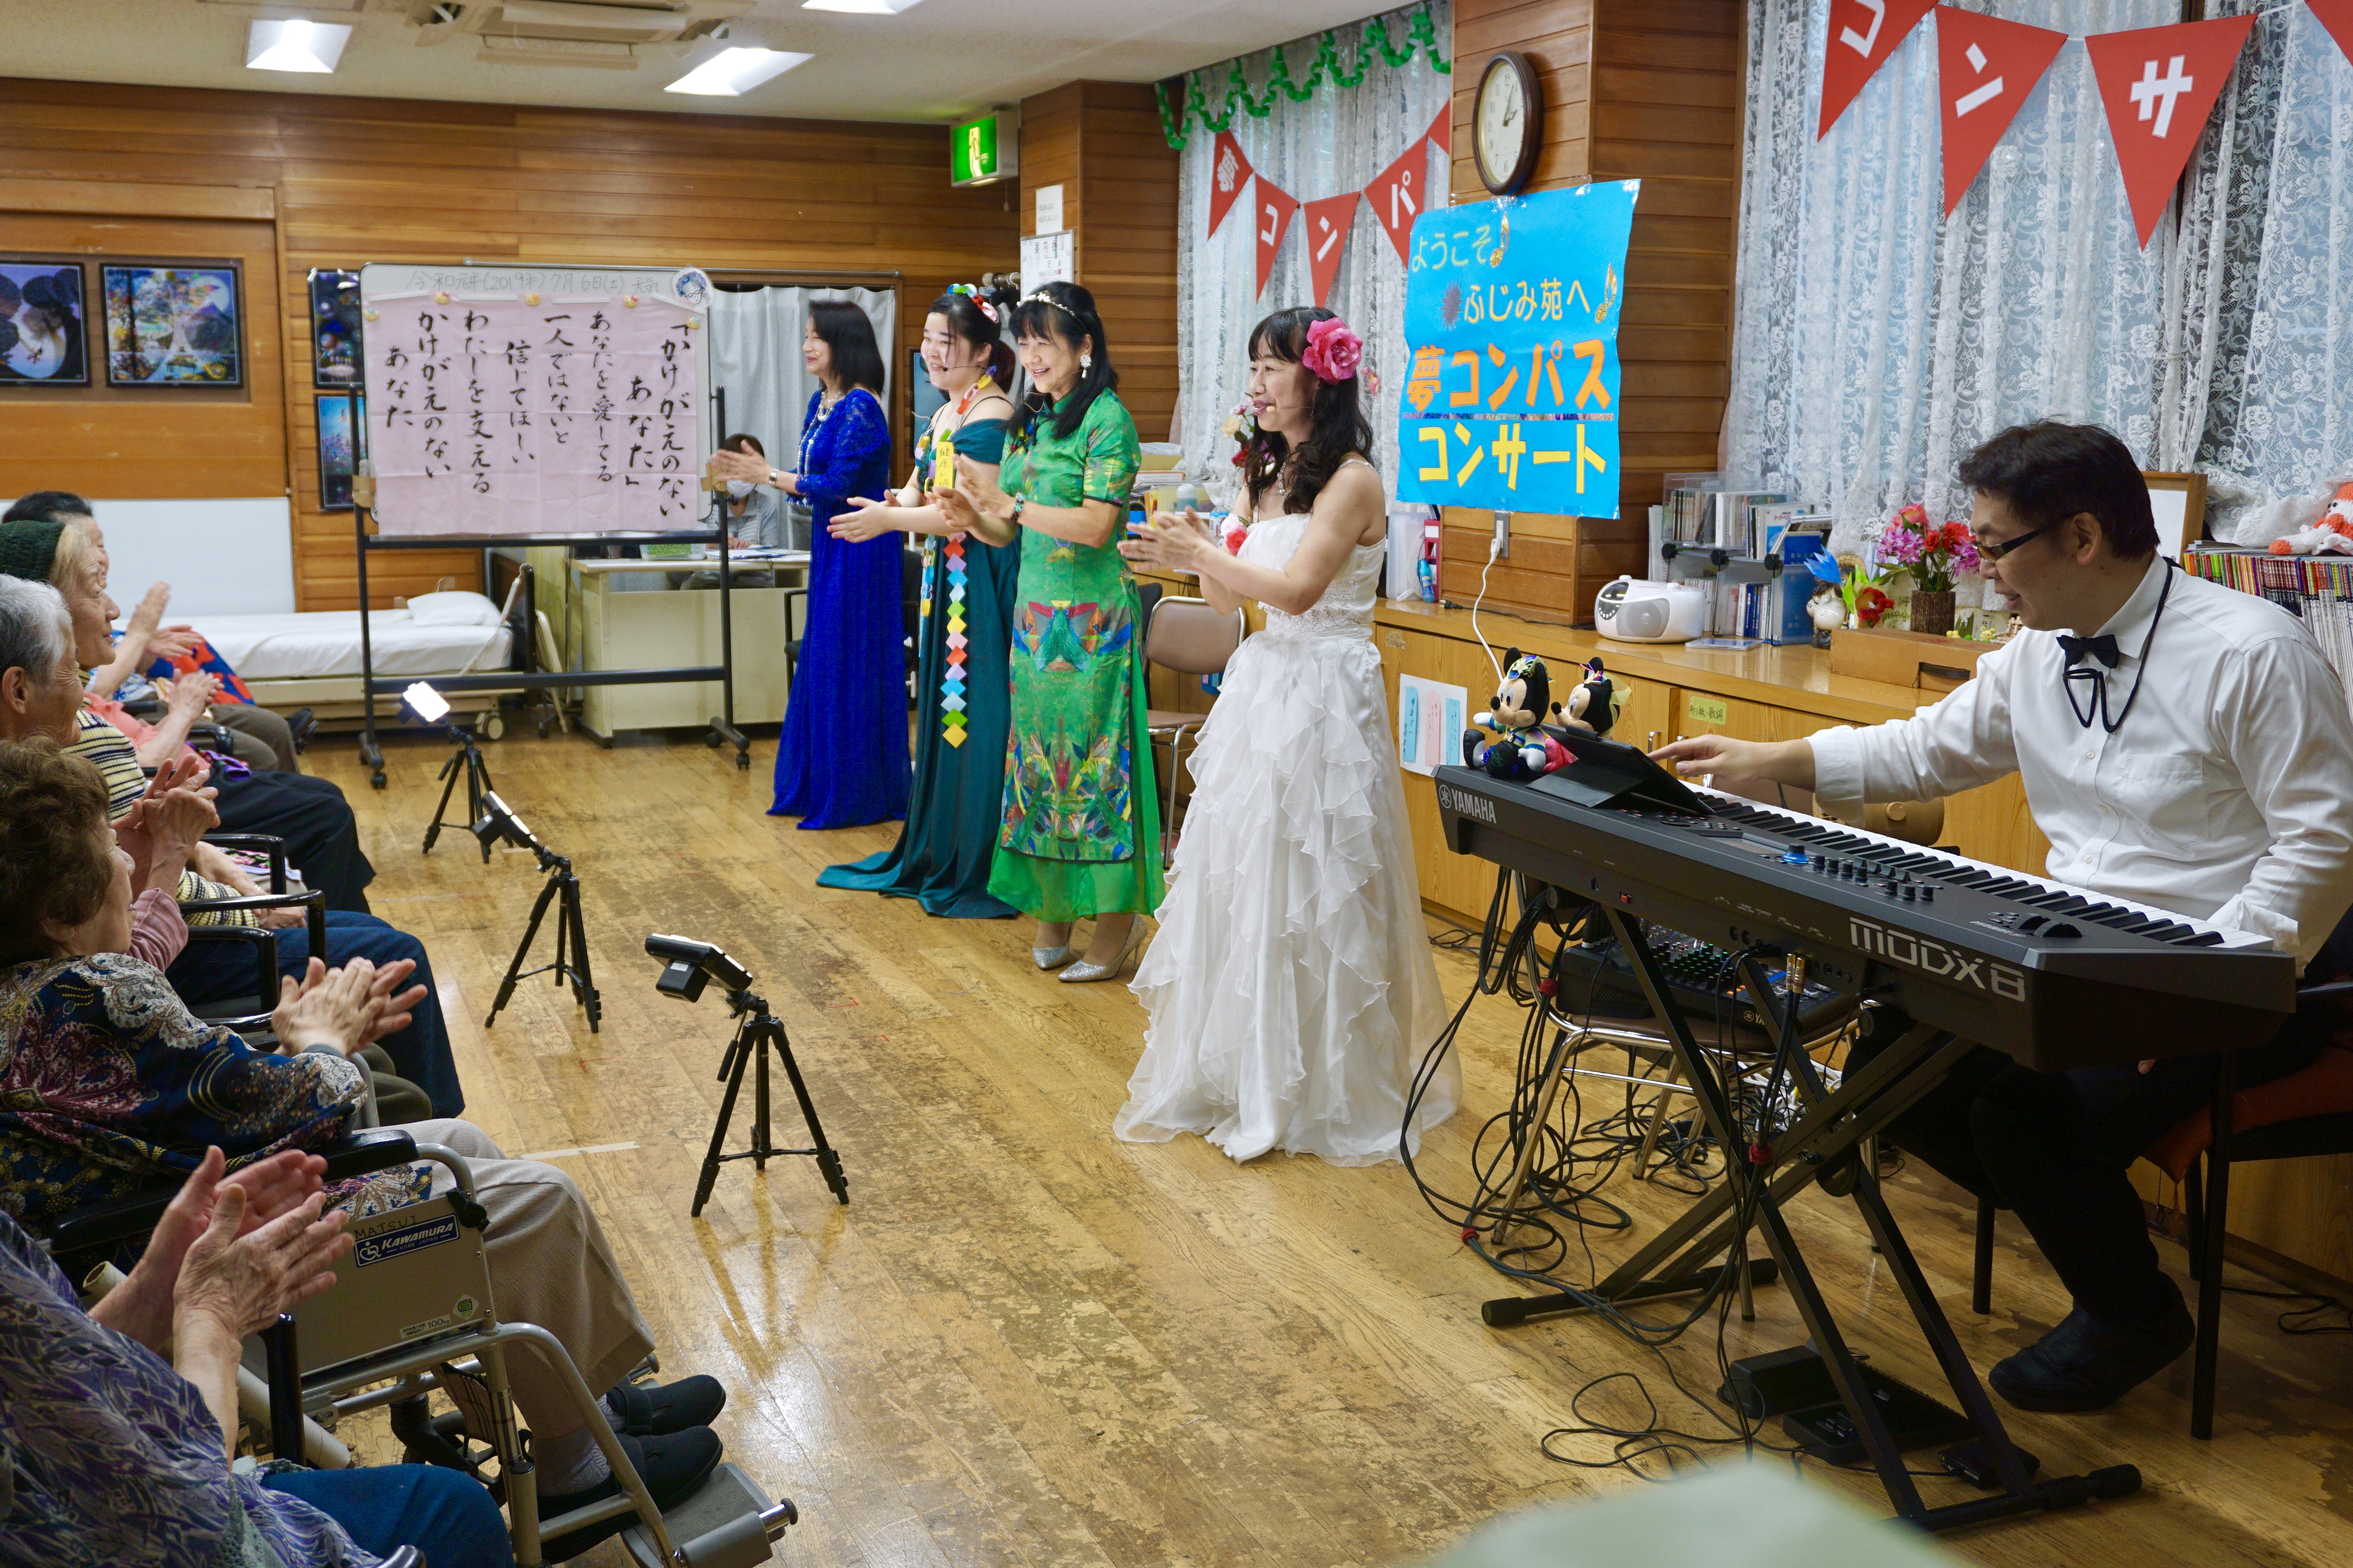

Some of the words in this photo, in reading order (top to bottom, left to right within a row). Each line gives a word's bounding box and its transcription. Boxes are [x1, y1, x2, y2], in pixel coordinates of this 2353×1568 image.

[1956, 42, 2004, 118] ン
[2129, 55, 2194, 139] サ
[1391, 170, 1416, 229] パ
[1412, 225, 1492, 272] ようこそ
[1463, 277, 1590, 323] ふじみ苑へ
[386, 346, 413, 428] あなた
[419, 312, 451, 478] かけがえのない
[464, 310, 493, 493] わたしを支える
[504, 340, 534, 463] 信じてほしい
[544, 315, 574, 443] 一人ではないと
[590, 311, 614, 481] あなたを愛してる
[1407, 338, 1611, 412] 夢コンパス
[1419, 420, 1606, 494] コンサート
[1451, 789, 1496, 824] YAMAHA
[1850, 917, 2025, 1002] MODX8
[354, 1216, 417, 1239] MATSUI
[382, 1223, 454, 1250] KAWAMURA
[419, 1236, 438, 1245] JAPAN
